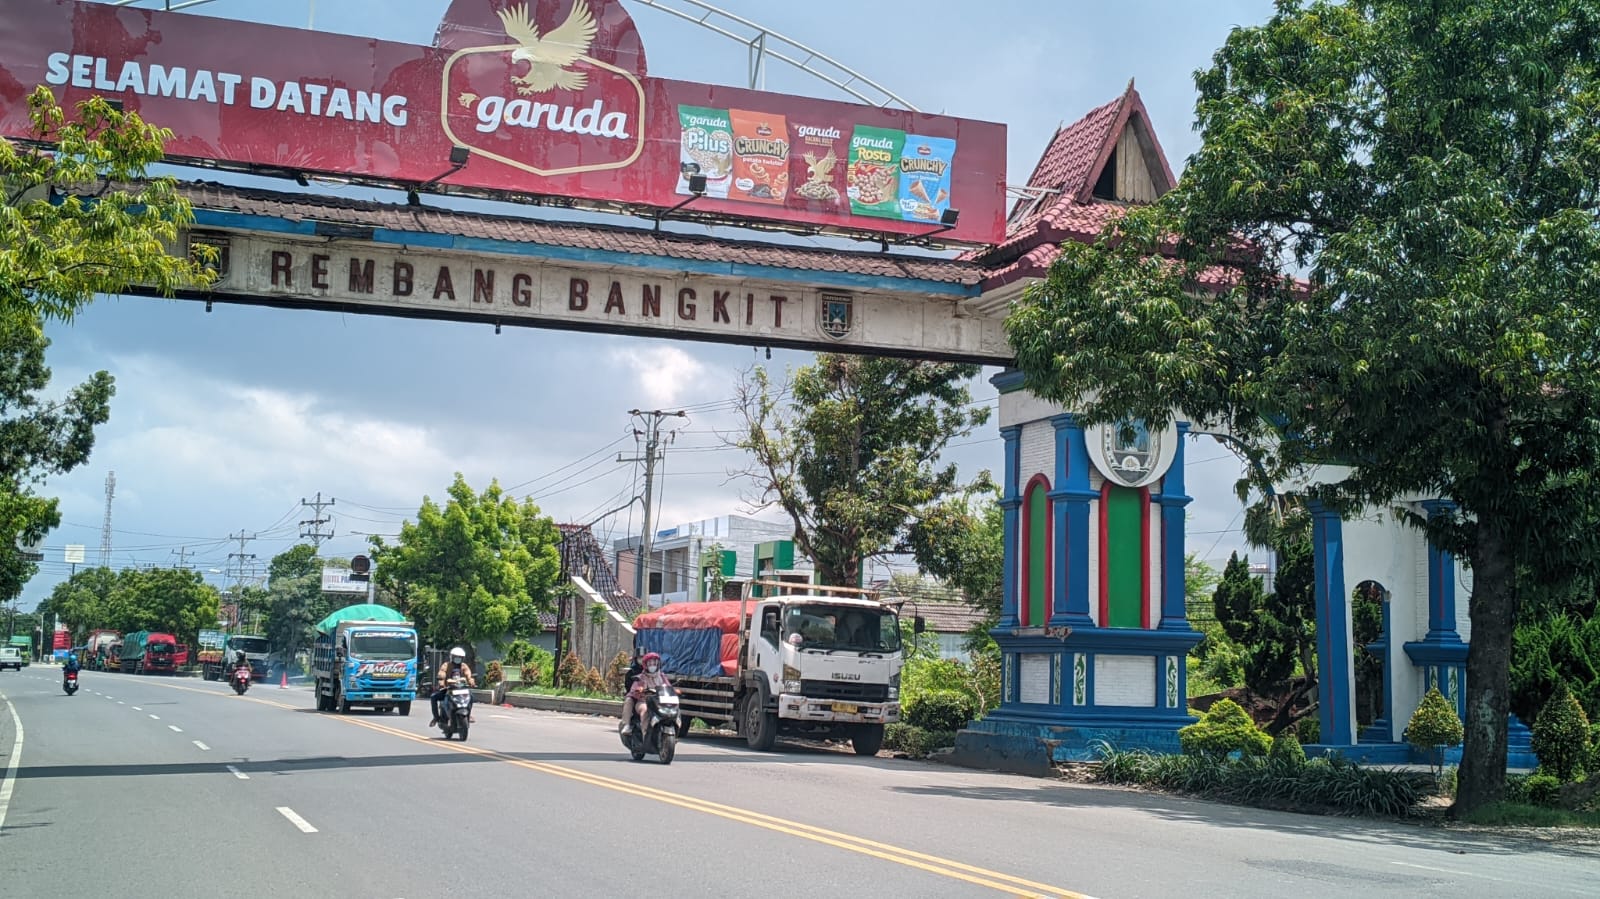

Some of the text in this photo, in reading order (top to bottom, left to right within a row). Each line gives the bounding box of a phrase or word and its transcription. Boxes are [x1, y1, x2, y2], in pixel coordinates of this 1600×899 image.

[45, 52, 408, 127] SELAMAT DATANG
[475, 95, 630, 140] garuda
[689, 116, 727, 128] garuda
[798, 125, 841, 140] garuda
[687, 130, 729, 154] Pilus
[734, 138, 790, 160] CRUNCHY
[852, 135, 894, 150] garuda
[857, 147, 892, 162] Rosta
[900, 158, 948, 176] CRUNCHY
[271, 250, 788, 328] REMBANG BANGKIT
[831, 672, 861, 681] ISUZU
